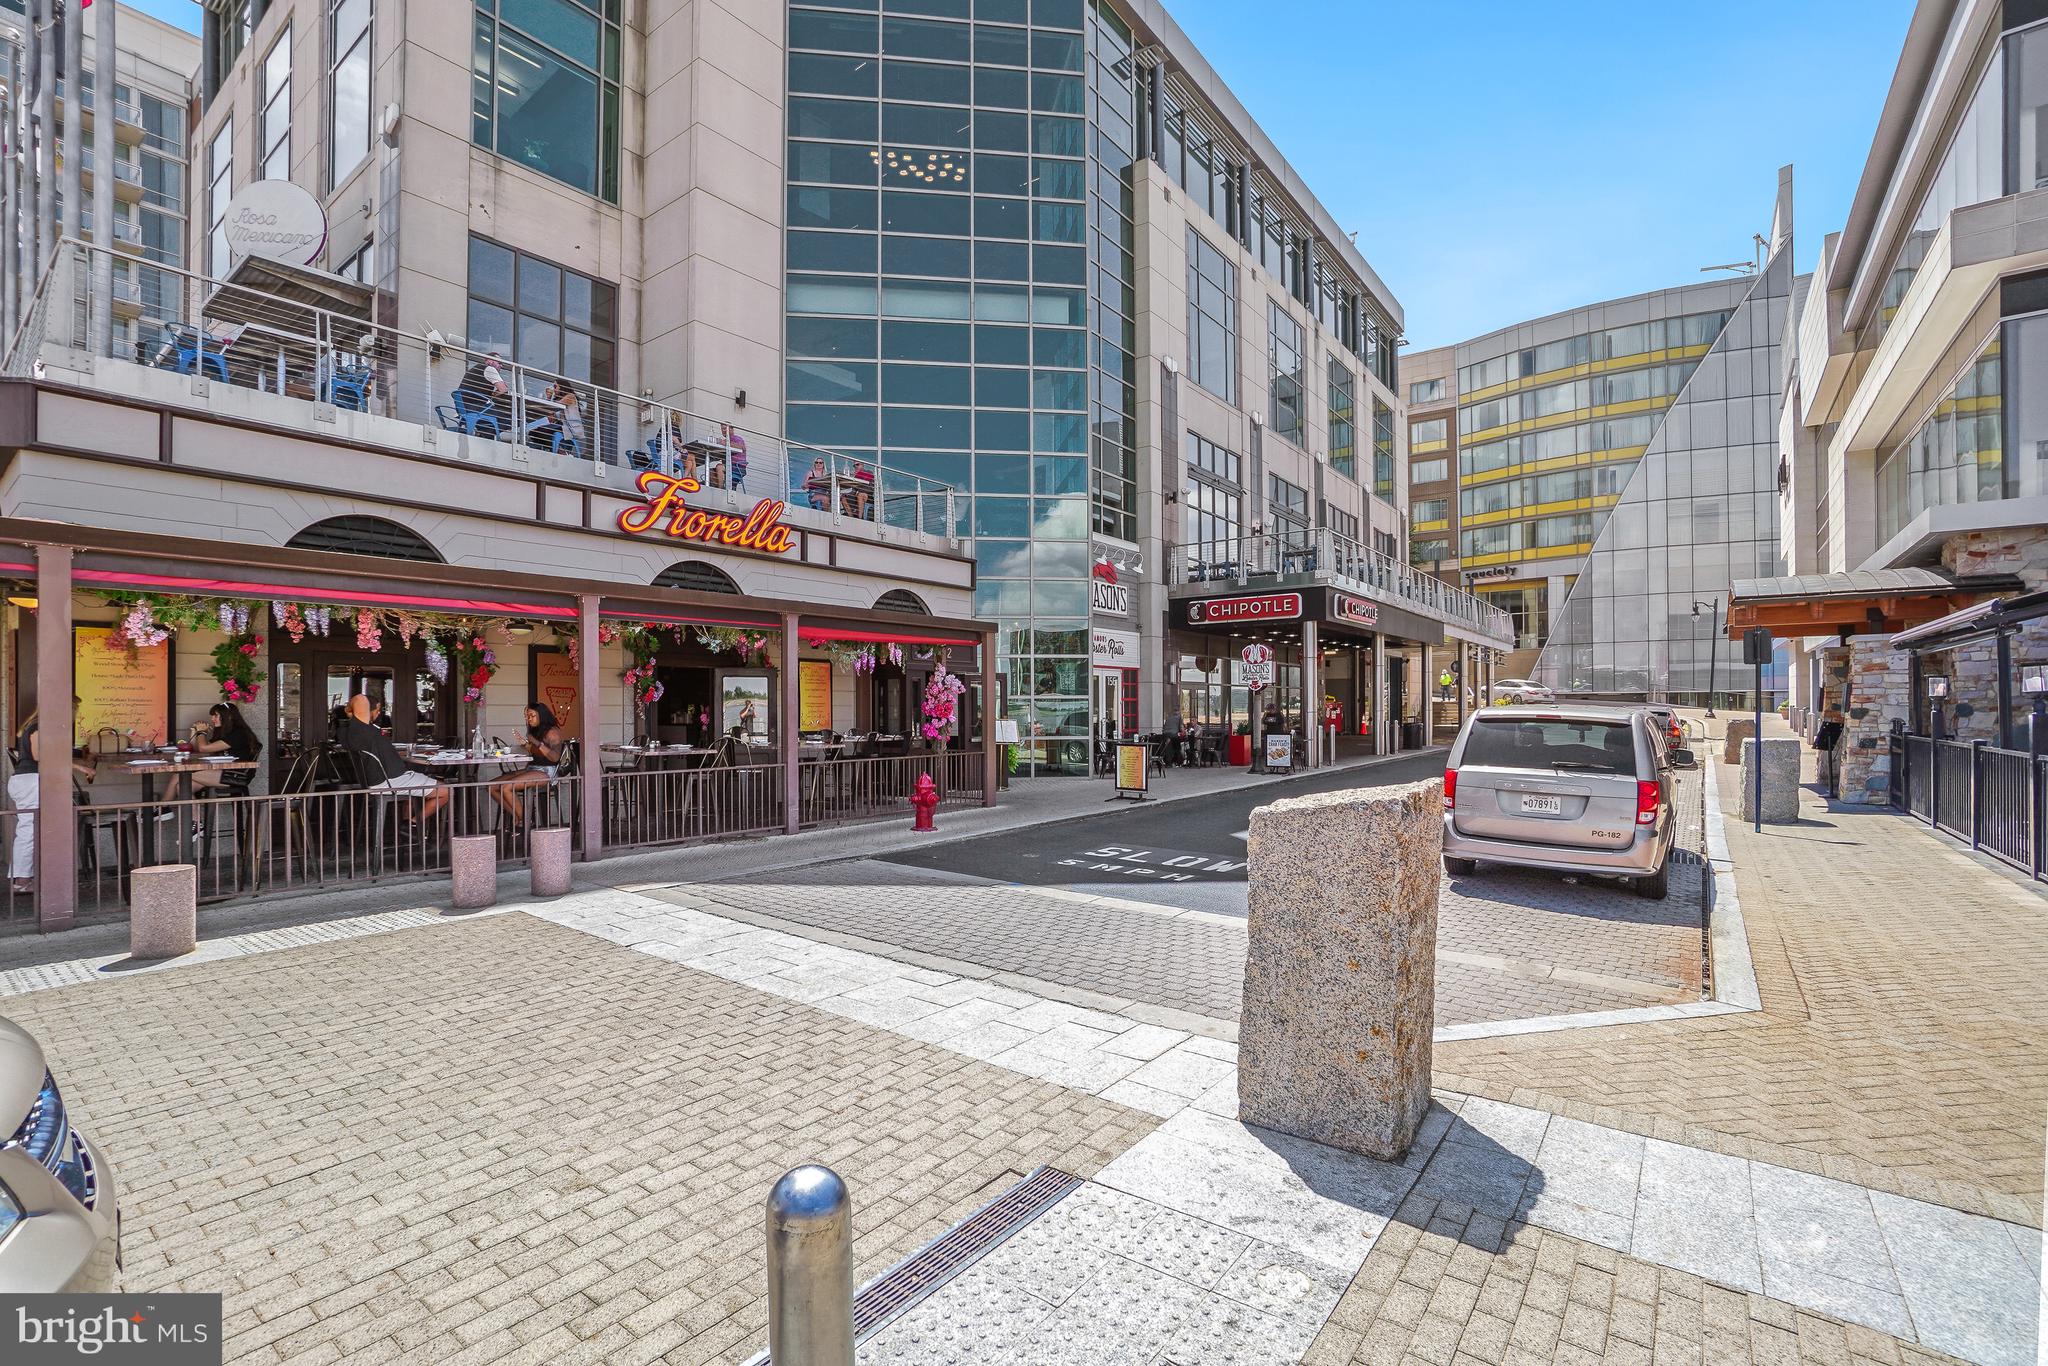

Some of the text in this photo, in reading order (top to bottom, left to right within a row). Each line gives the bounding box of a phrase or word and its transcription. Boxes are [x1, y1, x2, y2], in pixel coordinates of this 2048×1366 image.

[232, 207, 277, 226] Rosa
[232, 225, 313, 246] Mexicano
[617, 470, 797, 553] Fiorella
[1093, 582, 1127, 612] ASON'S
[1209, 599, 1293, 617] CHIPOTLE
[1352, 602, 1378, 620] CHIPOTLE
[1093, 634, 1107, 643] AMOUS
[1108, 638, 1125, 659] Rolls
[1242, 664, 1270, 674] MASON'S
[1528, 798, 1553, 809] 07891
[1591, 829, 1621, 839] PG-182
[1084, 846, 1248, 873] SLOW
